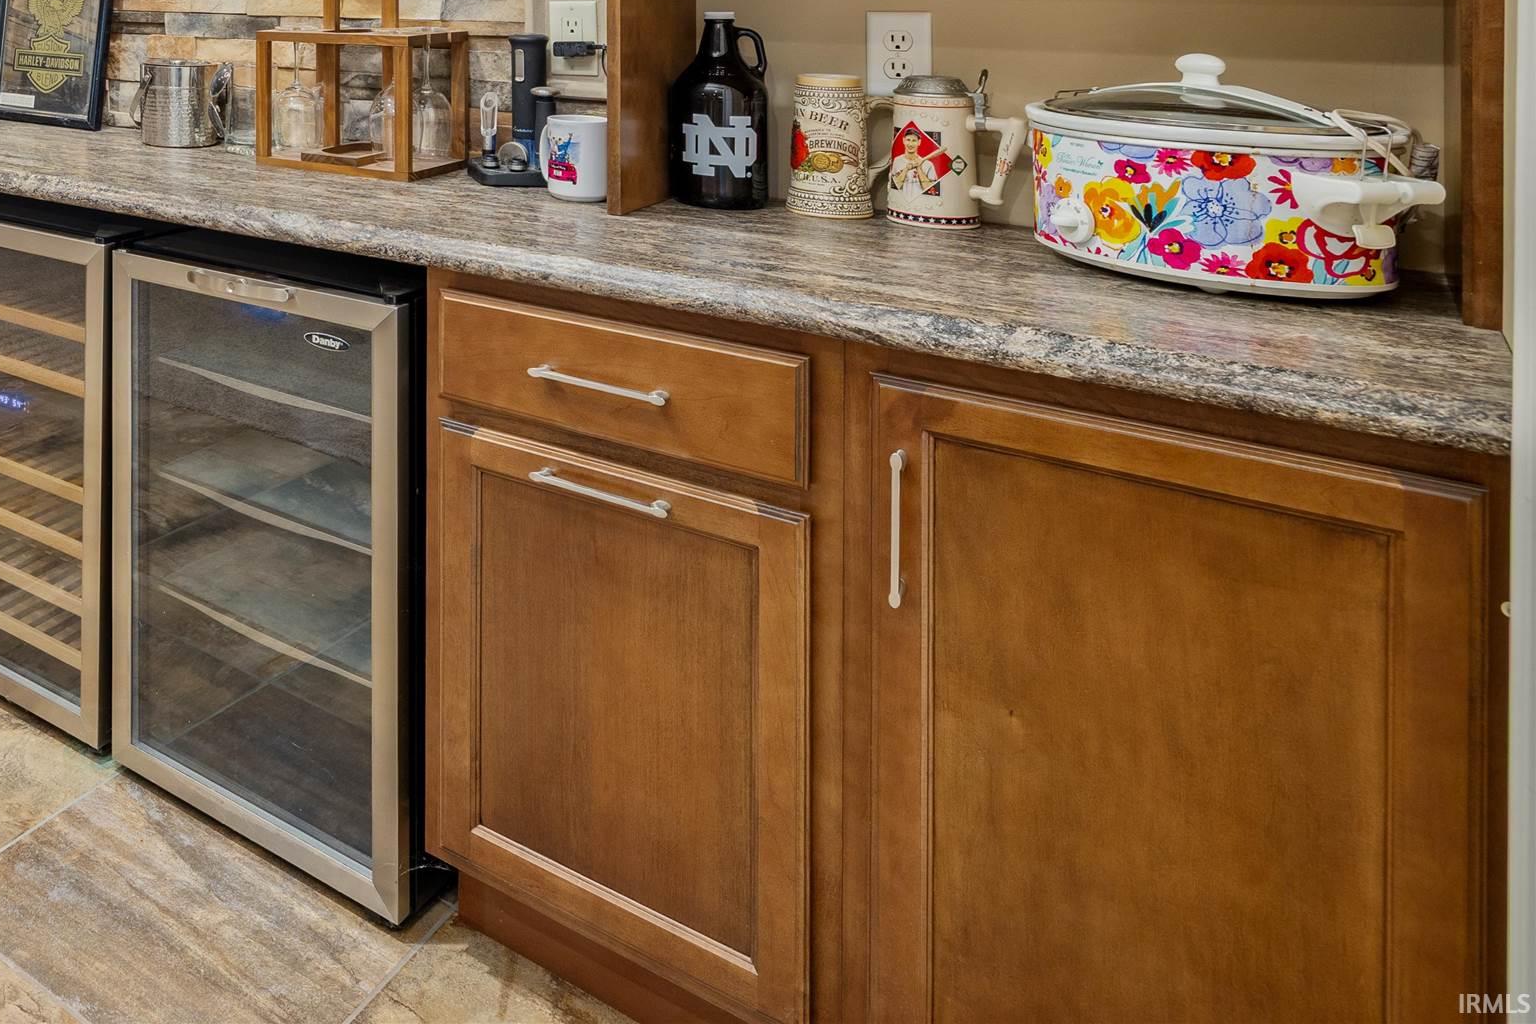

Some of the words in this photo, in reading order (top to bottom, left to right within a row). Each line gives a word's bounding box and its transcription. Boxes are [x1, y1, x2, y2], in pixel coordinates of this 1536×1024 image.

[35, 72, 60, 86] BLEND
[808, 110, 849, 131] BEER
[808, 139, 848, 152] BREWING
[311, 334, 341, 350] Danby
